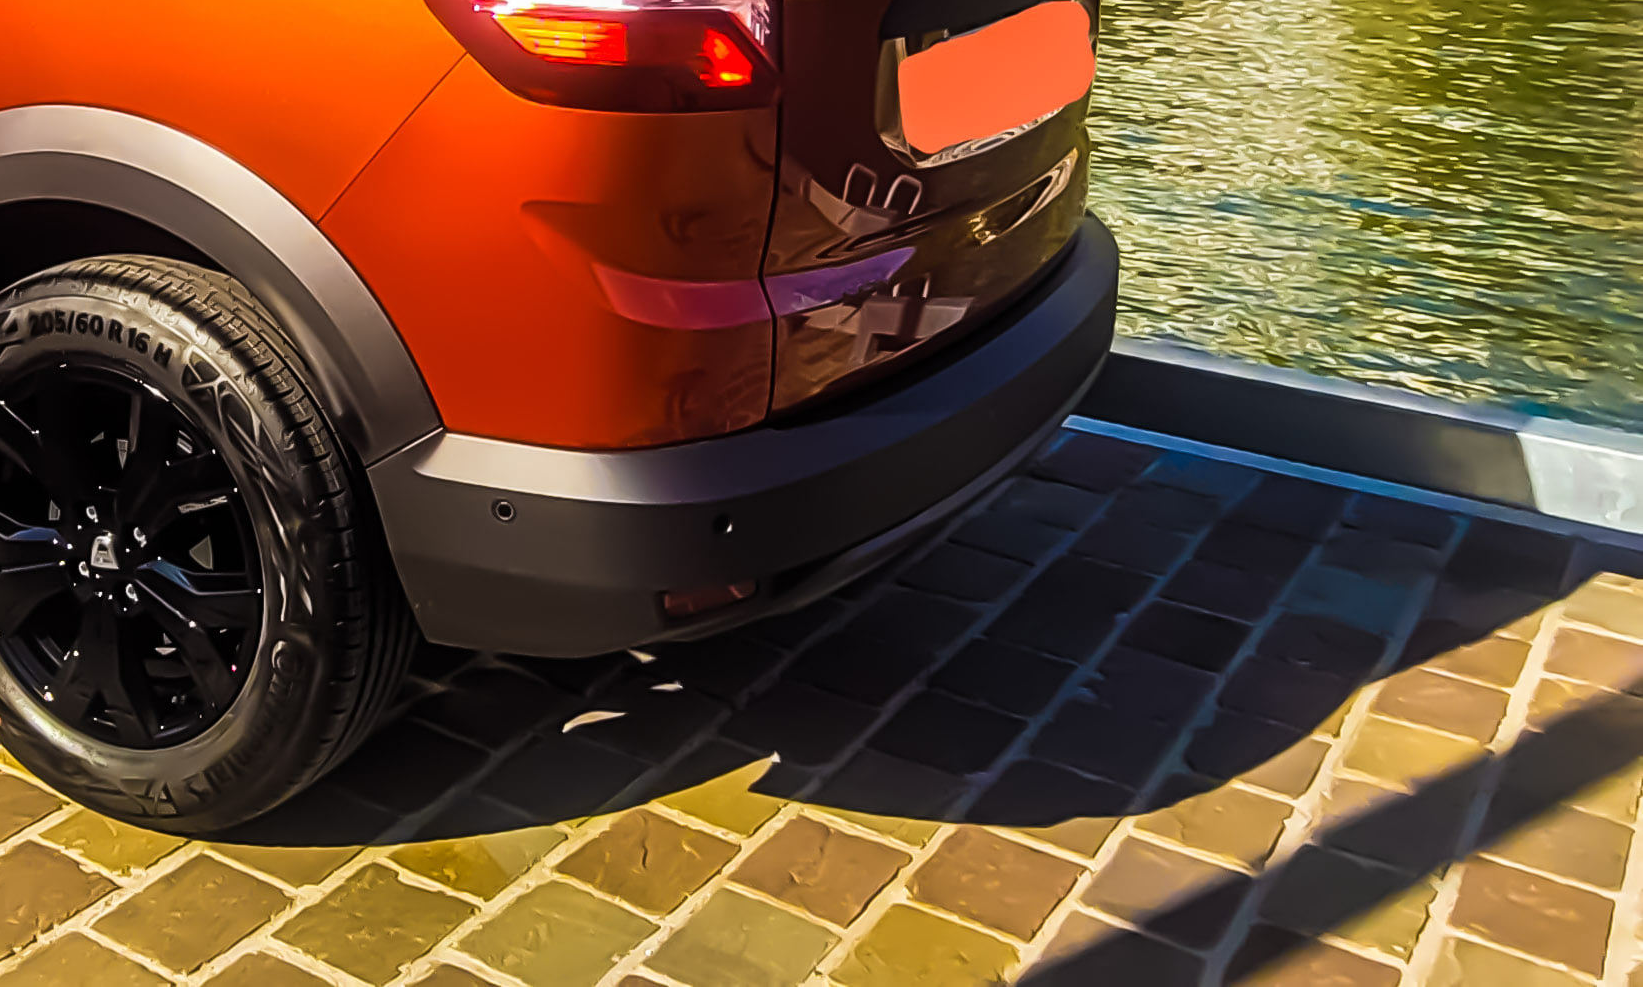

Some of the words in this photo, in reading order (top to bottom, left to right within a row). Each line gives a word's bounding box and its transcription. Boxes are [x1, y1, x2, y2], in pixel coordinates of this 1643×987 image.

[28, 310, 105, 338] 205/60
[107, 318, 124, 345] R
[126, 326, 152, 355] 16
[153, 341, 174, 369] H
